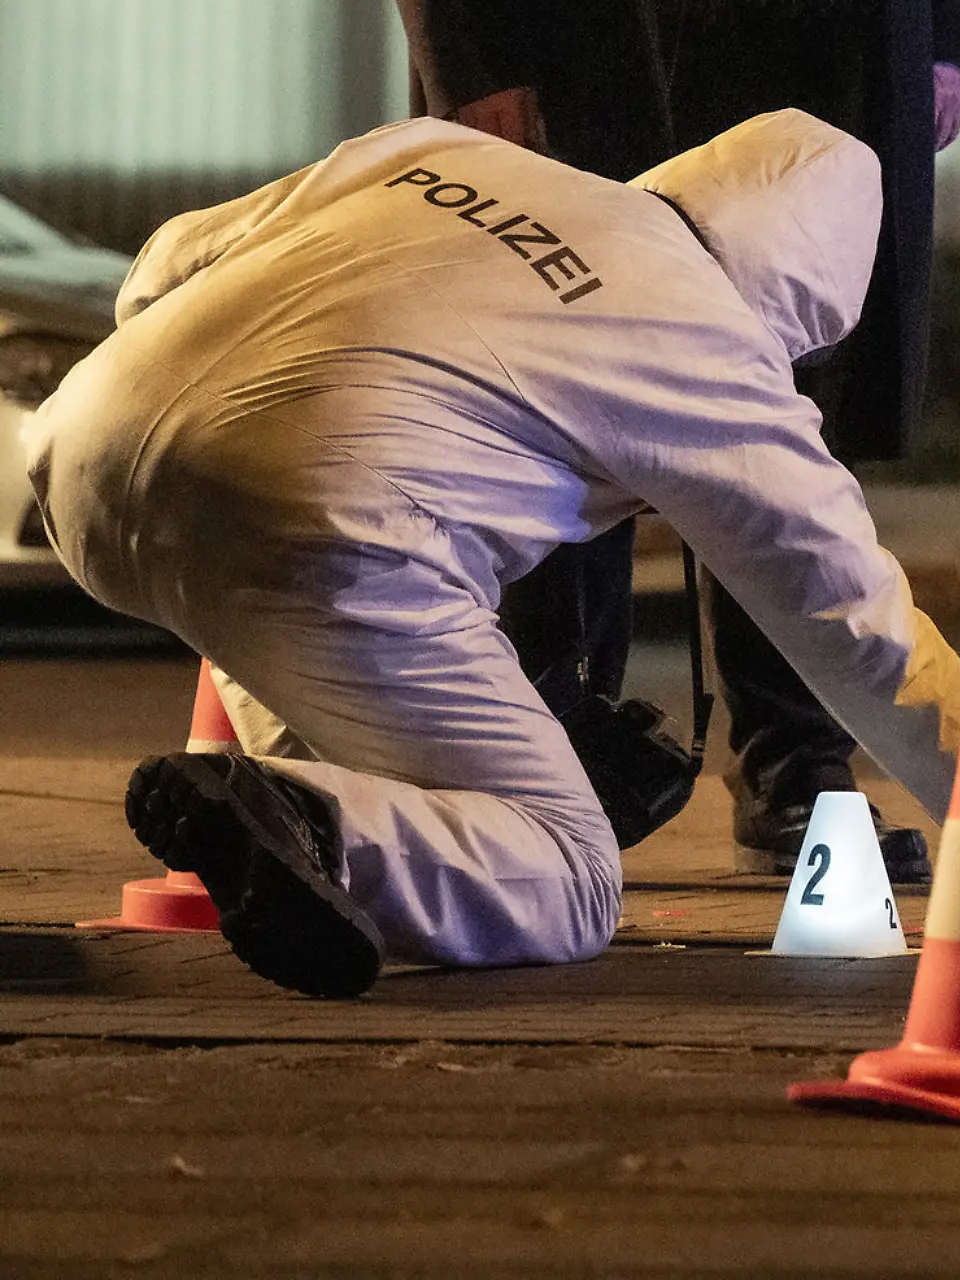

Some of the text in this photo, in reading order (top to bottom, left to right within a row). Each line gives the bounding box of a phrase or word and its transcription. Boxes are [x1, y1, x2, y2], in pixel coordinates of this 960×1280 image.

[384, 168, 602, 305] POLIZEI
[801, 843, 831, 905] 2
[885, 897, 898, 929] 2
